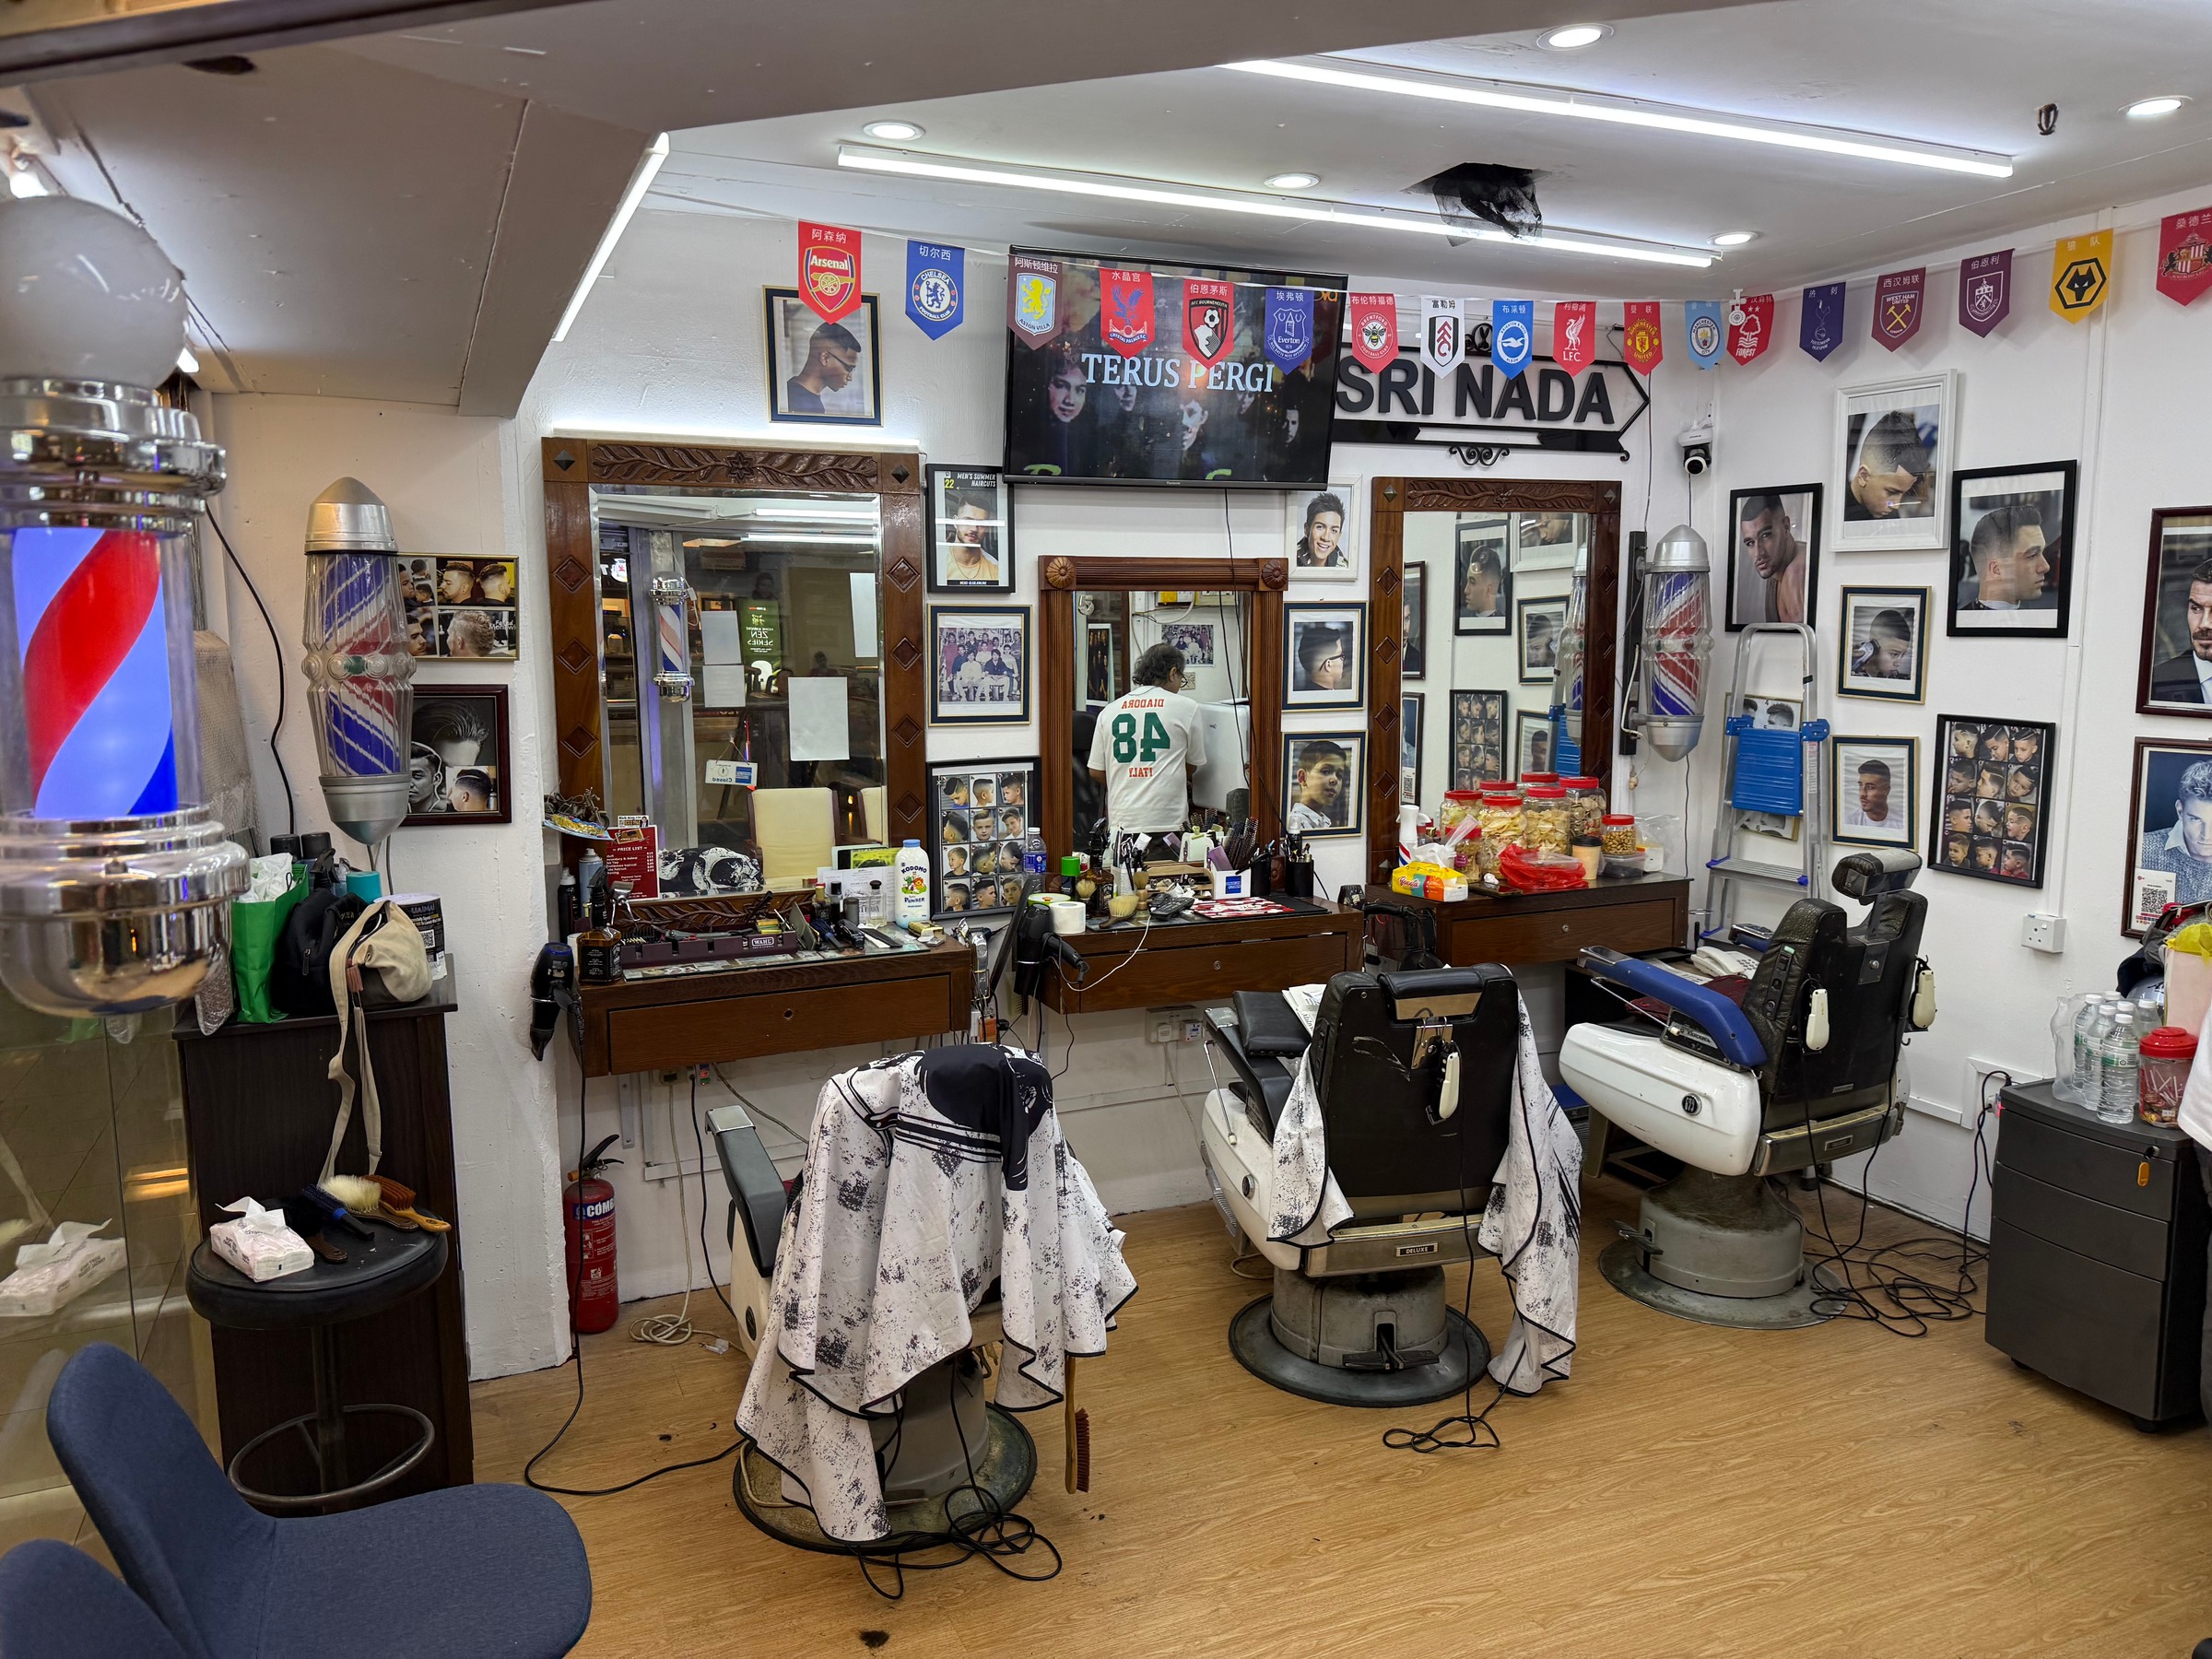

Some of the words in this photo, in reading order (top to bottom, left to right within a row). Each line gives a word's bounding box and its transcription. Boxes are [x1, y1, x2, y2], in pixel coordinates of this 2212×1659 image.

[811, 228, 847, 244] 阿森纳
[919, 244, 951, 261] 切尔西
[811, 255, 849, 270] Arsenal
[1015, 257, 1059, 275] 阿斯顿维拉
[1971, 254, 2000, 270] 伯恩利
[920, 271, 951, 286] CHELSEA
[1111, 270, 1141, 283] 水晶宫
[1883, 275, 1920, 288] 西汉姆联
[1190, 283, 1228, 297] 伯恩茅斯
[1276, 290, 1304, 302] 埃弗顿
[1351, 295, 1394, 306] 布伦特福德
[1886, 294, 1902, 302] WEST
[1431, 300, 1456, 310] 富勒姆
[1630, 304, 1653, 314] 曼联
[1018, 318, 1037, 331] ASTON
[1036, 323, 1051, 332] VILLA
[1360, 314, 1389, 327] BRENTFORD
[1277, 335, 1300, 345] Everton
[1633, 350, 1653, 359] UNITED
[1735, 347, 1757, 359] FOREST
[1081, 353, 1181, 389] TERUS
[1188, 361, 1276, 393] PERGI
[1336, 354, 1435, 415] SRI
[1454, 362, 1616, 424] NADA
[945, 478, 955, 488] 22
[971, 479, 996, 488] HAIRCUTS
[900, 865, 927, 875] KODOMO
[1406, 1246, 1429, 1254] DELUXE
